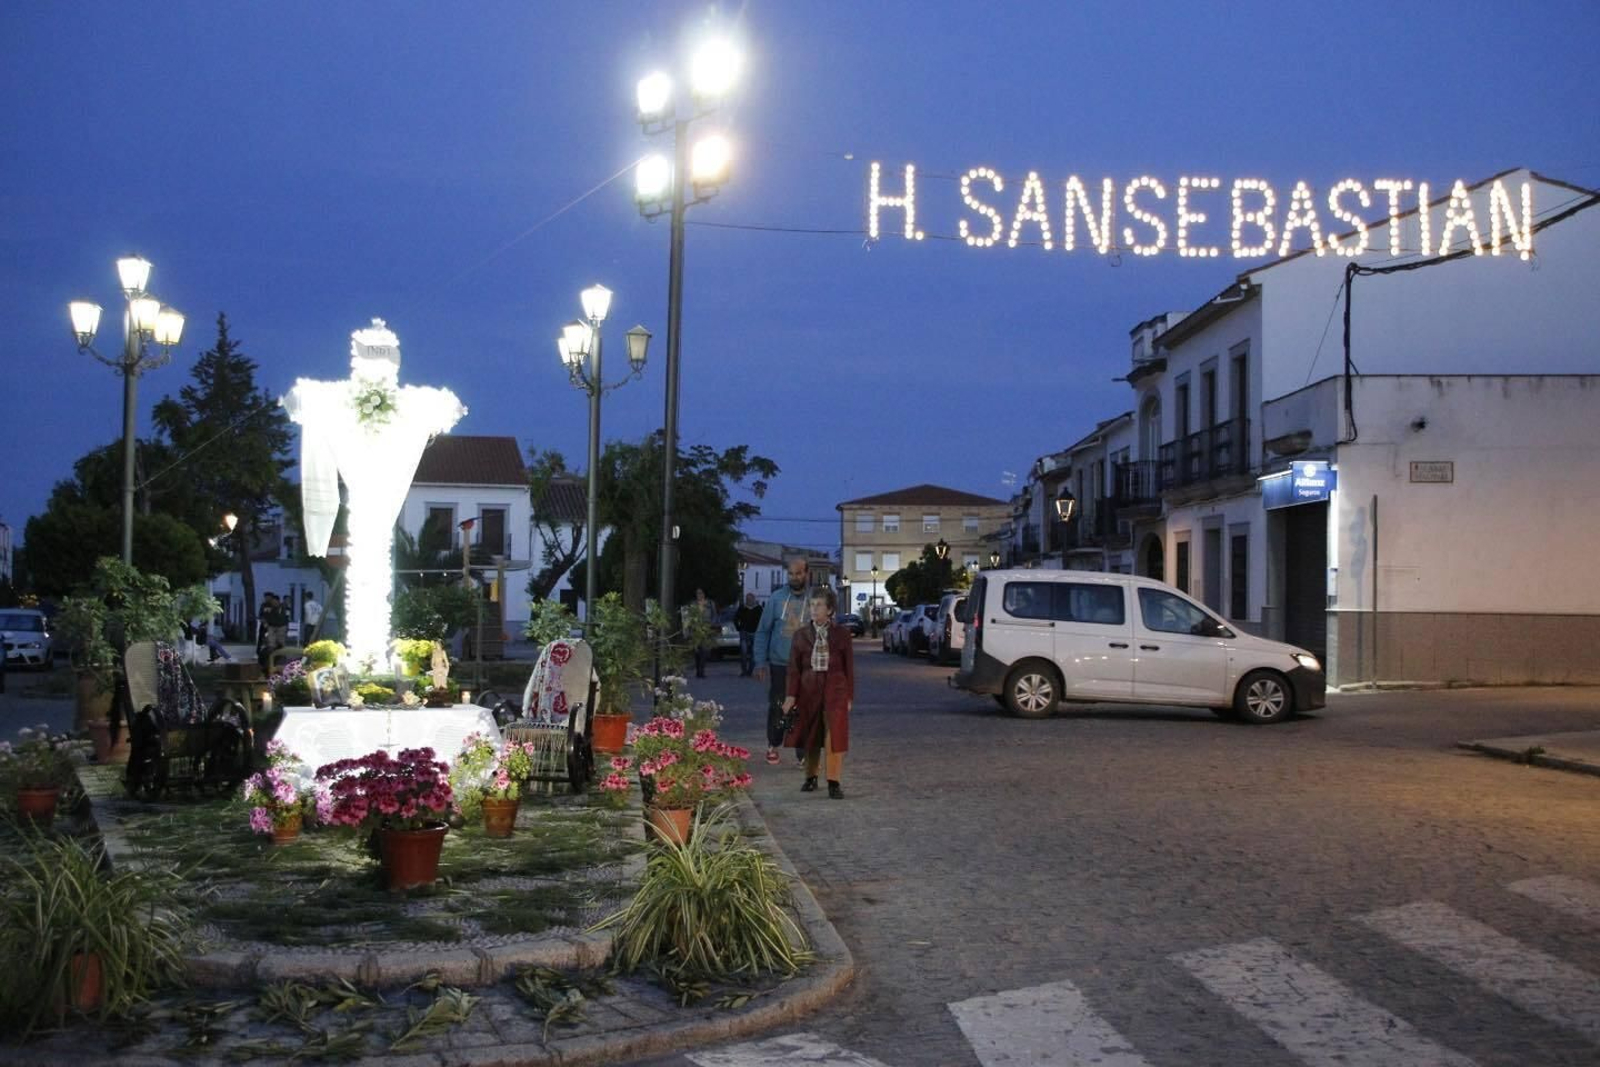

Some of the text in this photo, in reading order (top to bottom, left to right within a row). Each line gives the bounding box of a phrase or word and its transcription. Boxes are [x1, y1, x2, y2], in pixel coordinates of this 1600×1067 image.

[867, 161, 926, 242] H.
[1294, 477, 1326, 488] Allianz
[1298, 488, 1321, 498] Seguros
